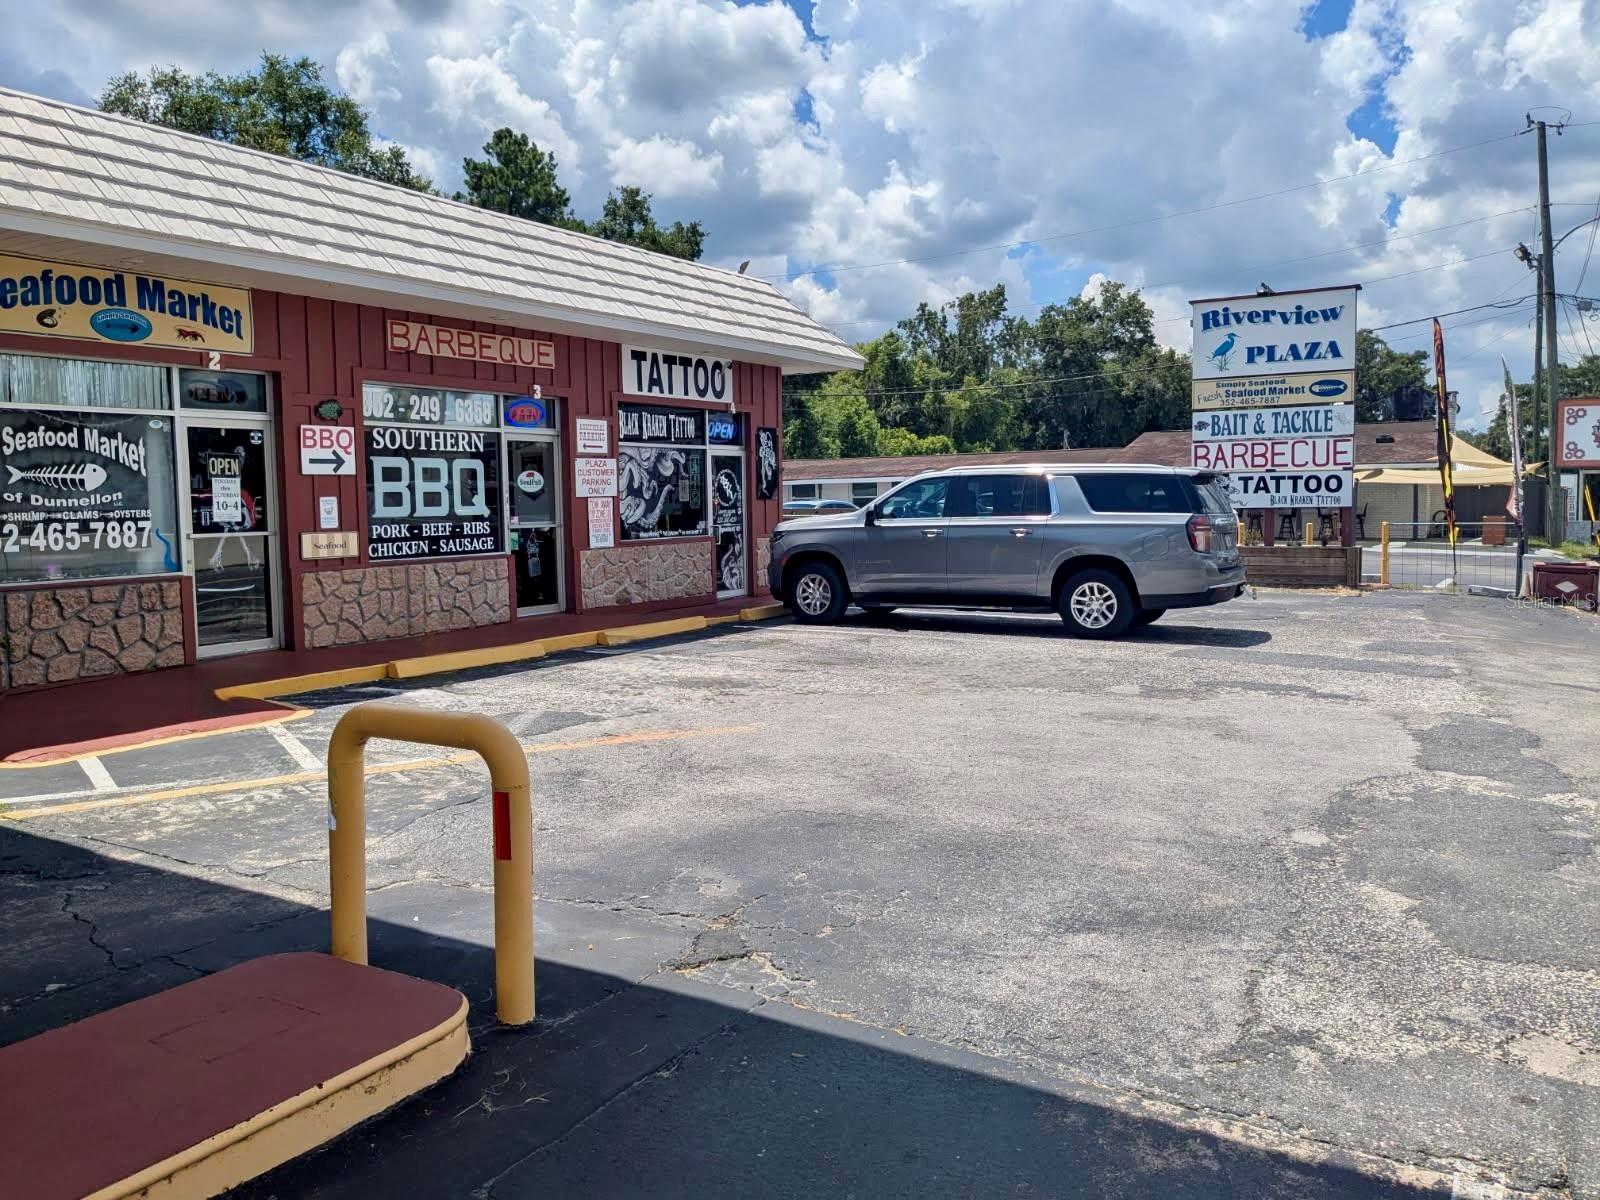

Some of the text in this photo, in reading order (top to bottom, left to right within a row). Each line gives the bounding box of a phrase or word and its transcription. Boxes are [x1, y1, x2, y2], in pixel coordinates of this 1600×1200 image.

[0, 269, 243, 340] eafood Market
[1200, 304, 1345, 333] Riverview
[389, 321, 554, 368] BARBEQUE
[1244, 340, 1343, 365] PLAZA
[208, 351, 221, 370] 2
[631, 349, 725, 399] TATTOO
[1215, 378, 1286, 389] Simply Seafood
[533, 384, 541, 399] 3
[1224, 387, 1268, 399] Seafood
[1268, 385, 1306, 396] Market
[409, 395, 440, 421] 249
[455, 398, 492, 424] 6358
[730, 402, 737, 415] 4
[1219, 396, 1281, 407] 352-465-7887
[668, 414, 695, 441] TATTOO
[708, 421, 735, 439] OPEN
[1210, 409, 1333, 437] BAIT & TACKLE
[302, 427, 353, 455] BBQ
[372, 428, 485, 453] SOUTHERN
[2, 426, 147, 478] Seafood Market
[1193, 439, 1353, 470] BARBECUE
[208, 457, 240, 476] OPEN
[577, 468, 615, 477] CUSTOMER
[585, 460, 607, 468] PLAZA
[370, 456, 491, 518] BBQ
[582, 477, 611, 486] PARKING
[588, 487, 606, 495] ONLY
[1238, 474, 1343, 494] TATTOO
[2, 492, 123, 507] of Dunnellon
[215, 500, 239, 511] 10-4
[8, 509, 152, 521] SHRIMP CLAMS OYSTERS
[0, 520, 152, 552] 2-465-7887
[372, 525, 409, 539] PORK
[421, 522, 453, 537] BEEF
[463, 521, 490, 535] RIBS
[368, 540, 429, 558] CHICKEN
[439, 537, 495, 552] SAUSAGE
